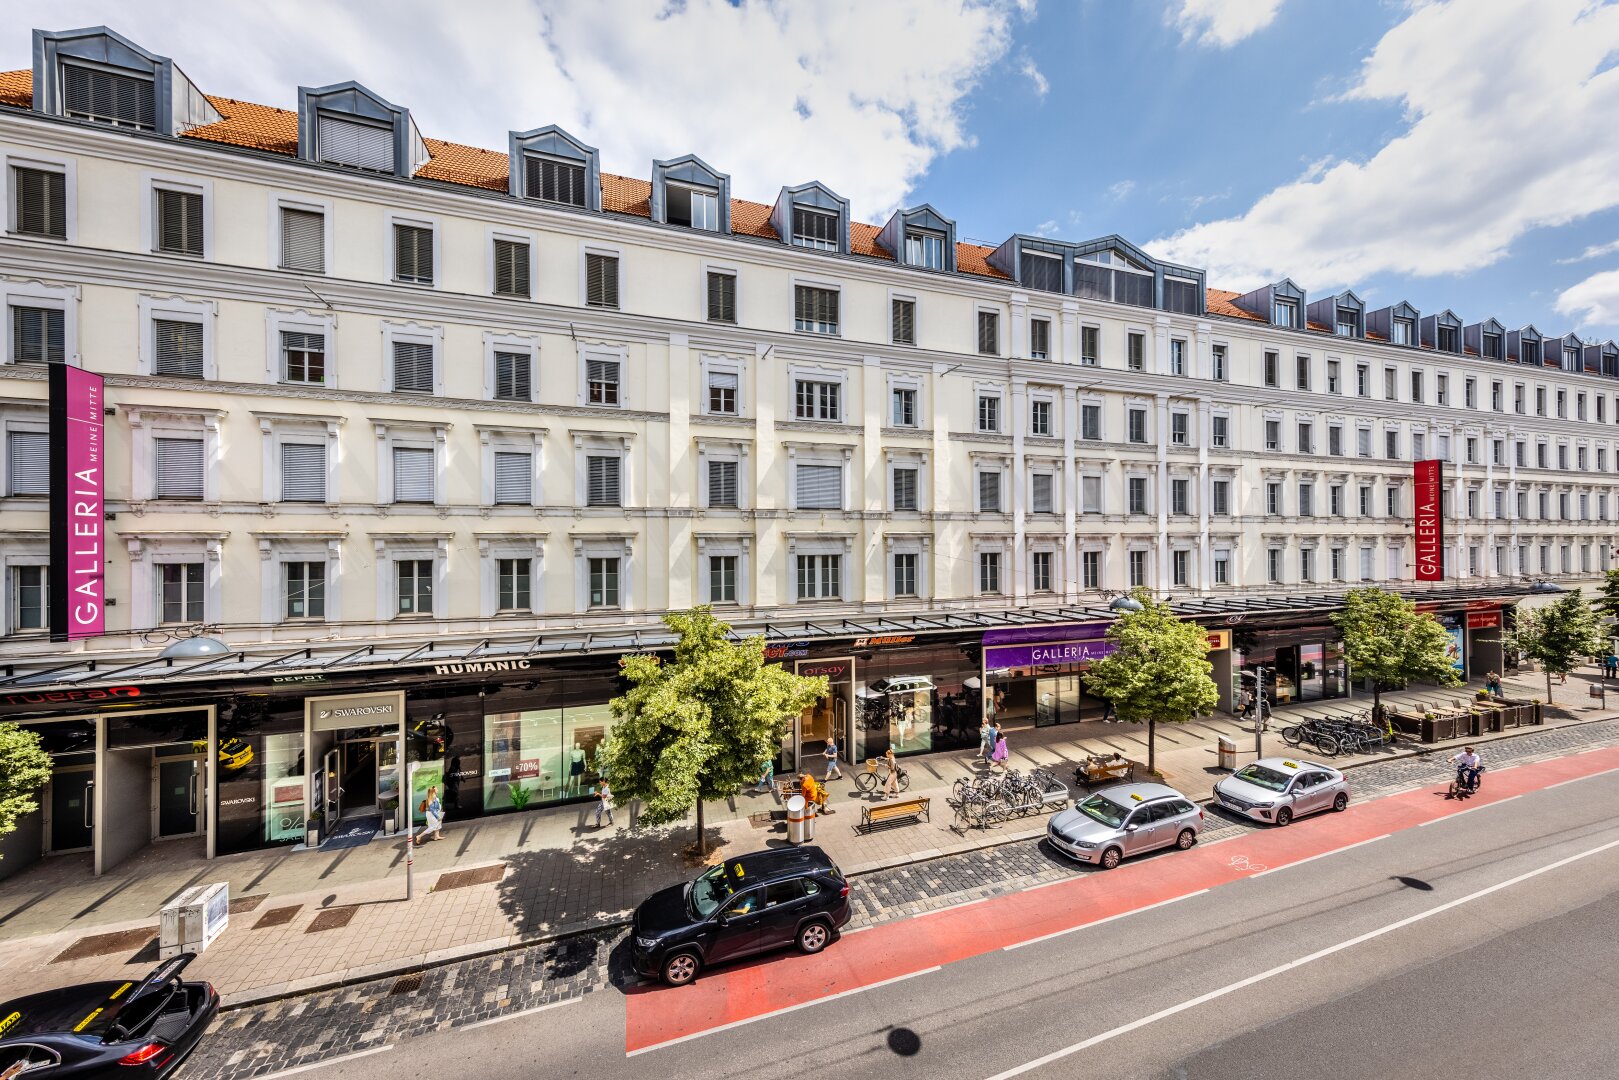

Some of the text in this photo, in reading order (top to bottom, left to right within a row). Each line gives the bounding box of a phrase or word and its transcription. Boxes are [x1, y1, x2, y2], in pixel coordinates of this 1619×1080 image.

[75, 385, 98, 625] GALLERIA MEINE MITTE
[1420, 503, 1436, 575] GALLERIA
[1032, 646, 1090, 660] GALLERIA
[434, 660, 531, 675] HUMANIC
[803, 665, 845, 677] orsay
[334, 705, 392, 718] SWAROVSKI
[220, 797, 256, 806] SWAROVSKI
[1, 1012, 20, 1030] TAXI
